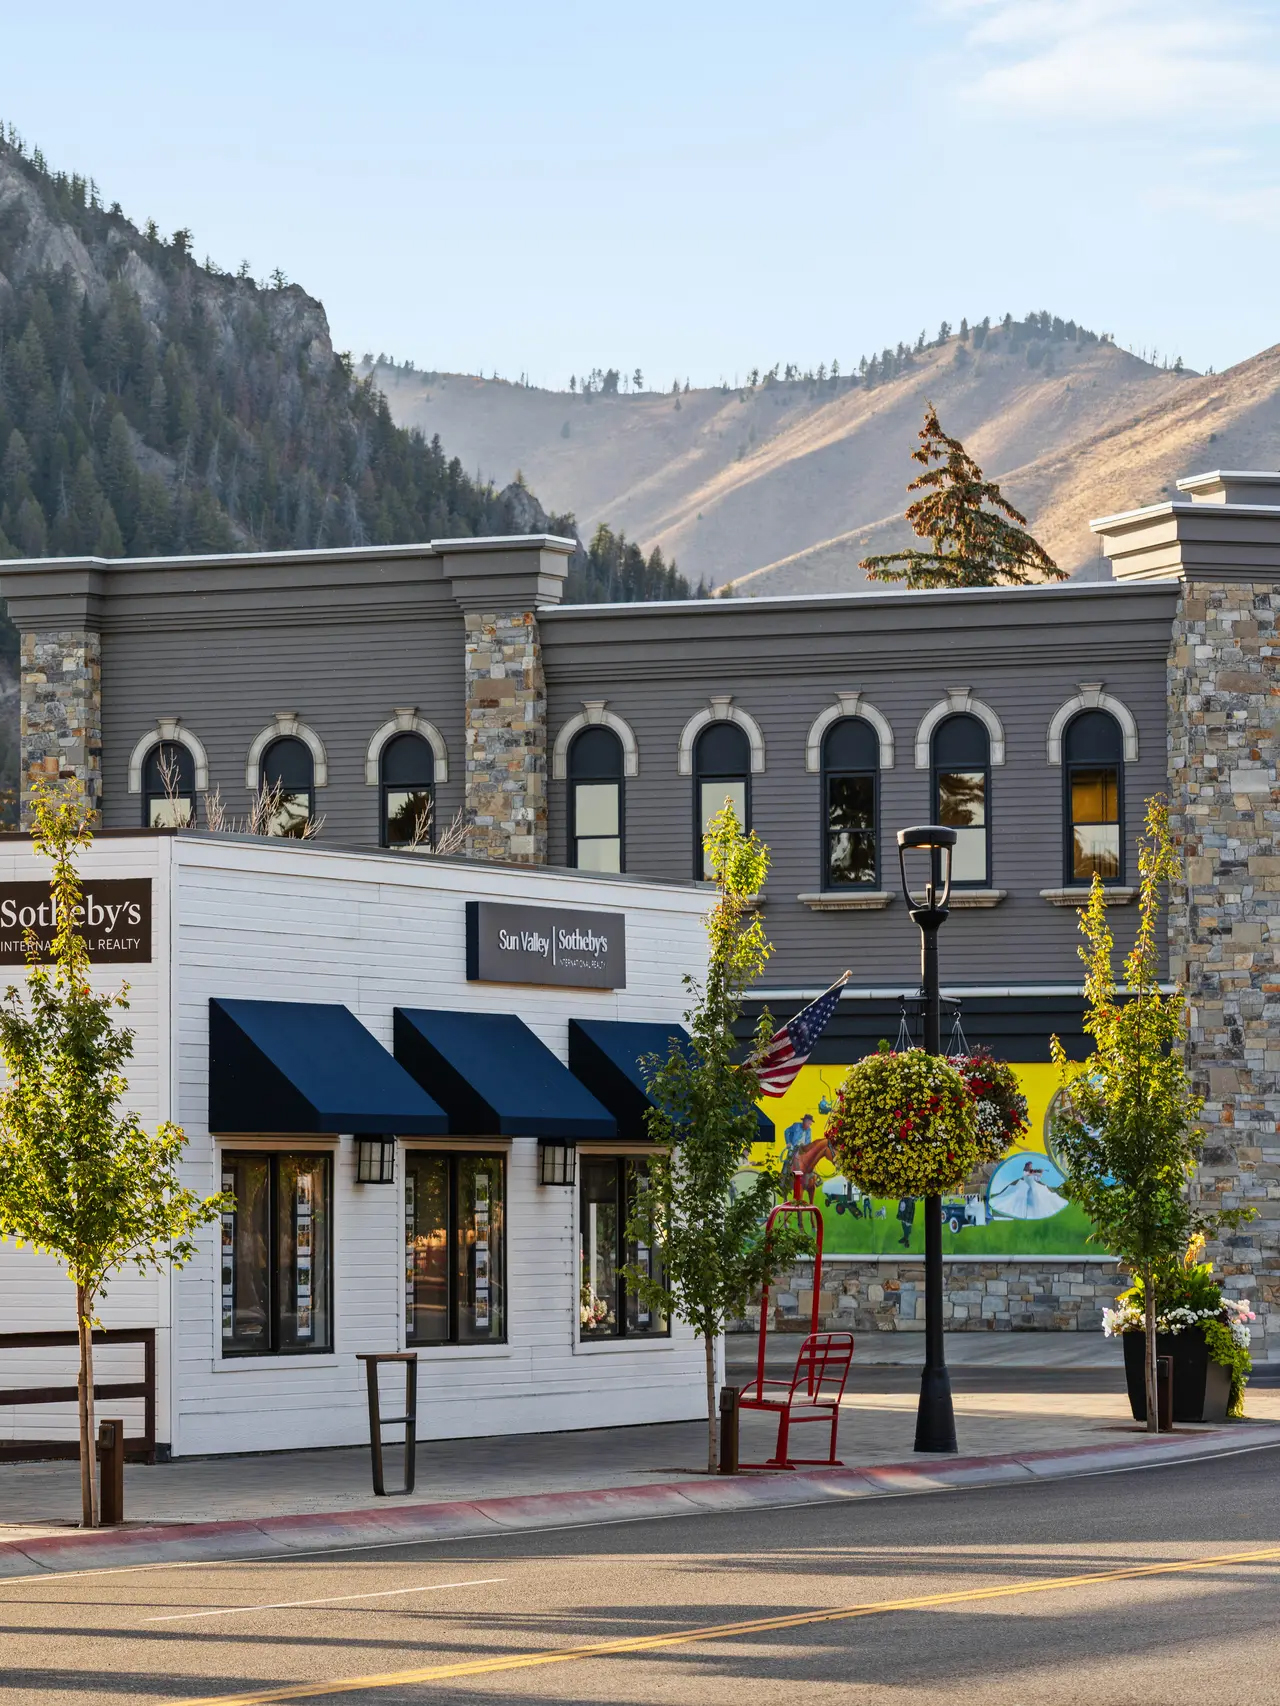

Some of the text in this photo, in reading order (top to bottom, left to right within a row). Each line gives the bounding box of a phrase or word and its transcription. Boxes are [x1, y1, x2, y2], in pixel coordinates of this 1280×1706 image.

[98, 938, 141, 950] REALTY
[499, 928, 608, 957] Sun Valley Sotheby's
